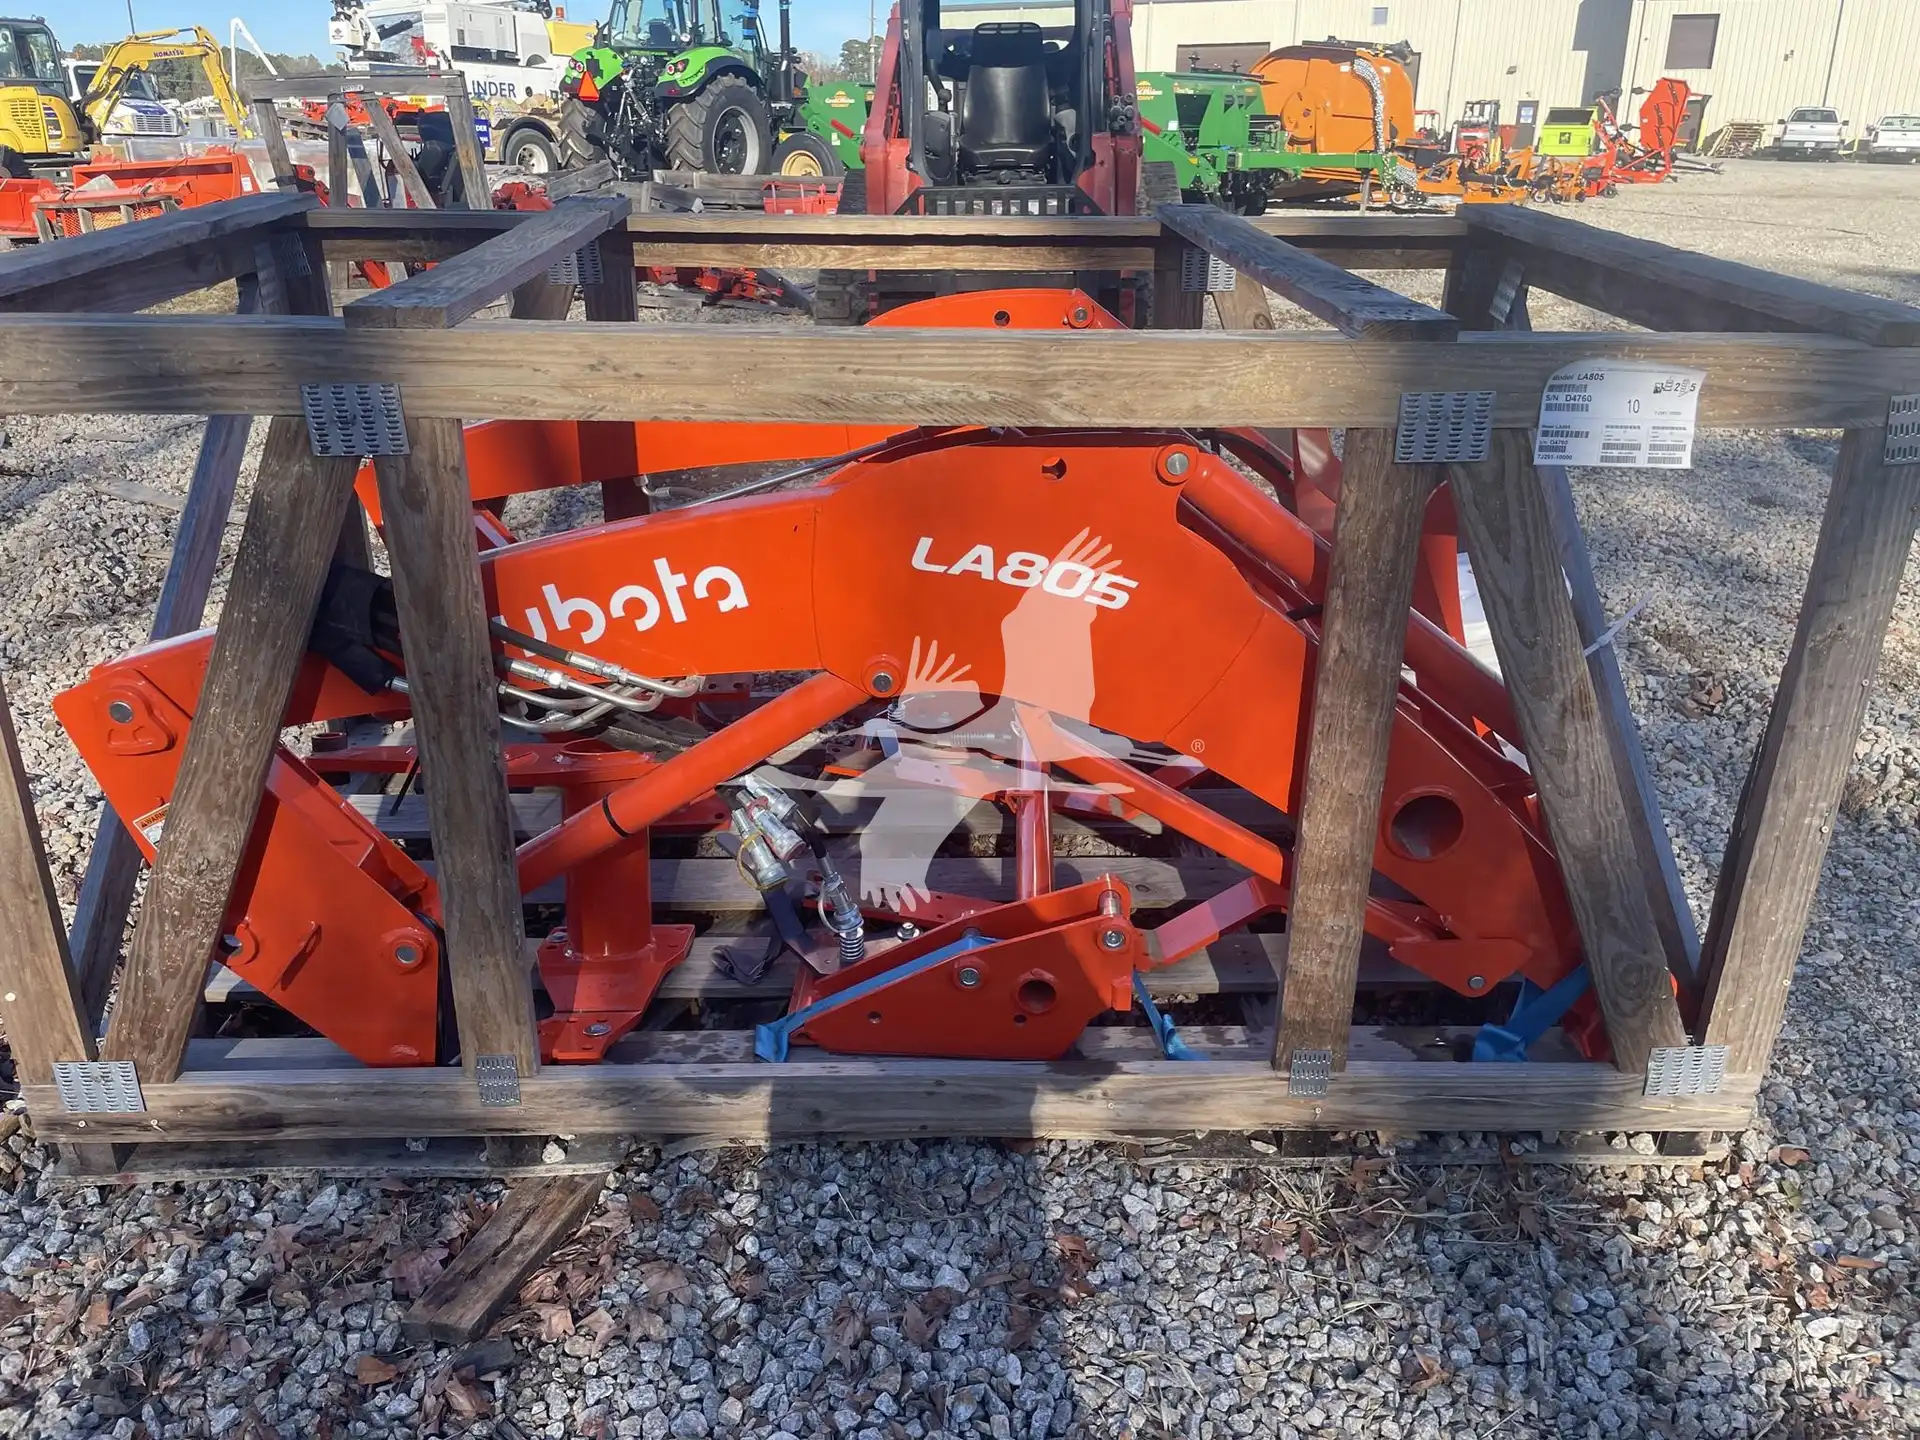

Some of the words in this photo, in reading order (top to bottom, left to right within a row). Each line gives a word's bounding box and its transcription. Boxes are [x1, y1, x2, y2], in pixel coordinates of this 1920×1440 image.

[153, 49, 184, 58] KOMATSU
[1577, 373, 1605, 381] LA805
[1545, 394, 1559, 402] S/N
[1565, 394, 1592, 402] D4760
[1627, 399, 1640, 414] 10
[911, 536, 1139, 610] LA805
[492, 557, 749, 657] ubota
